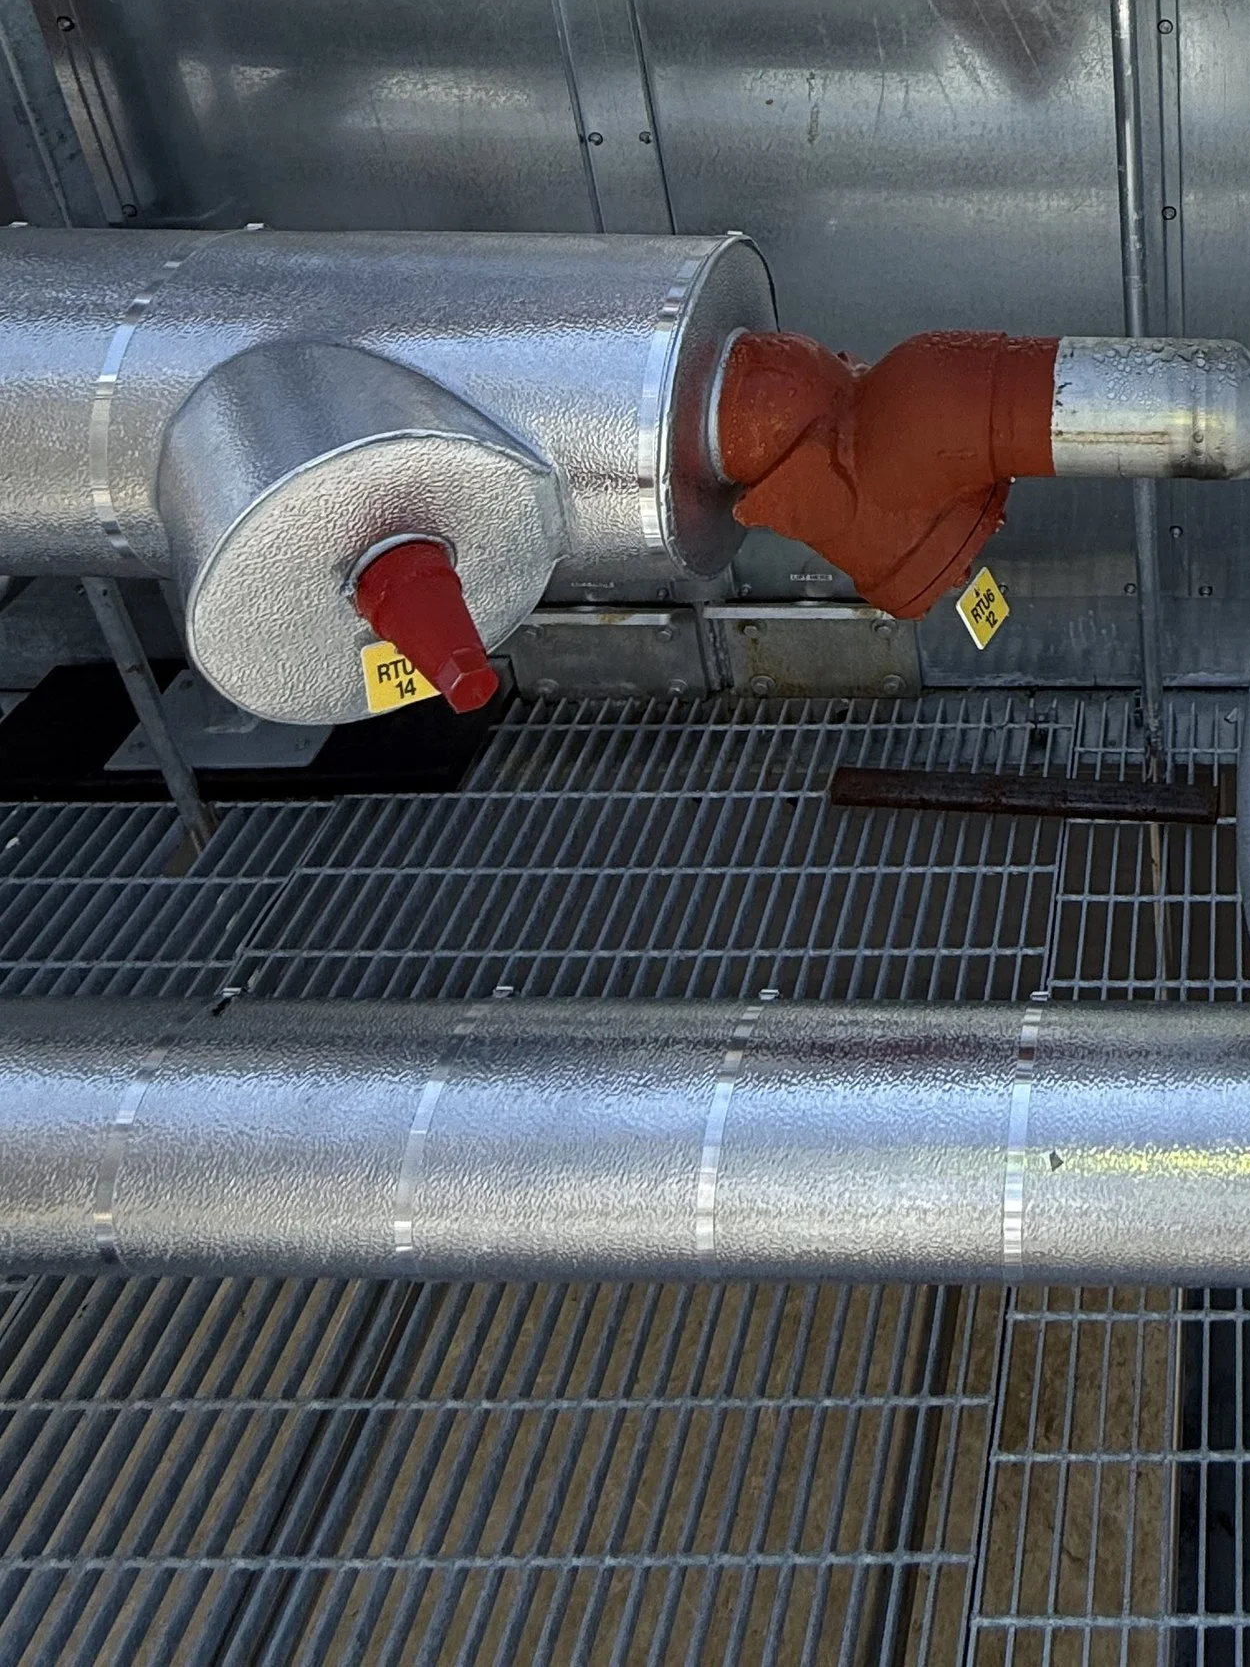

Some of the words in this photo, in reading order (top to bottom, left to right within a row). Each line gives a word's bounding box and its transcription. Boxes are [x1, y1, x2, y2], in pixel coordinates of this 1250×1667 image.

[971, 588, 996, 625] RTU6
[985, 610, 999, 629] 12
[377, 657, 417, 685] RTU
[395, 677, 417, 700] 14
